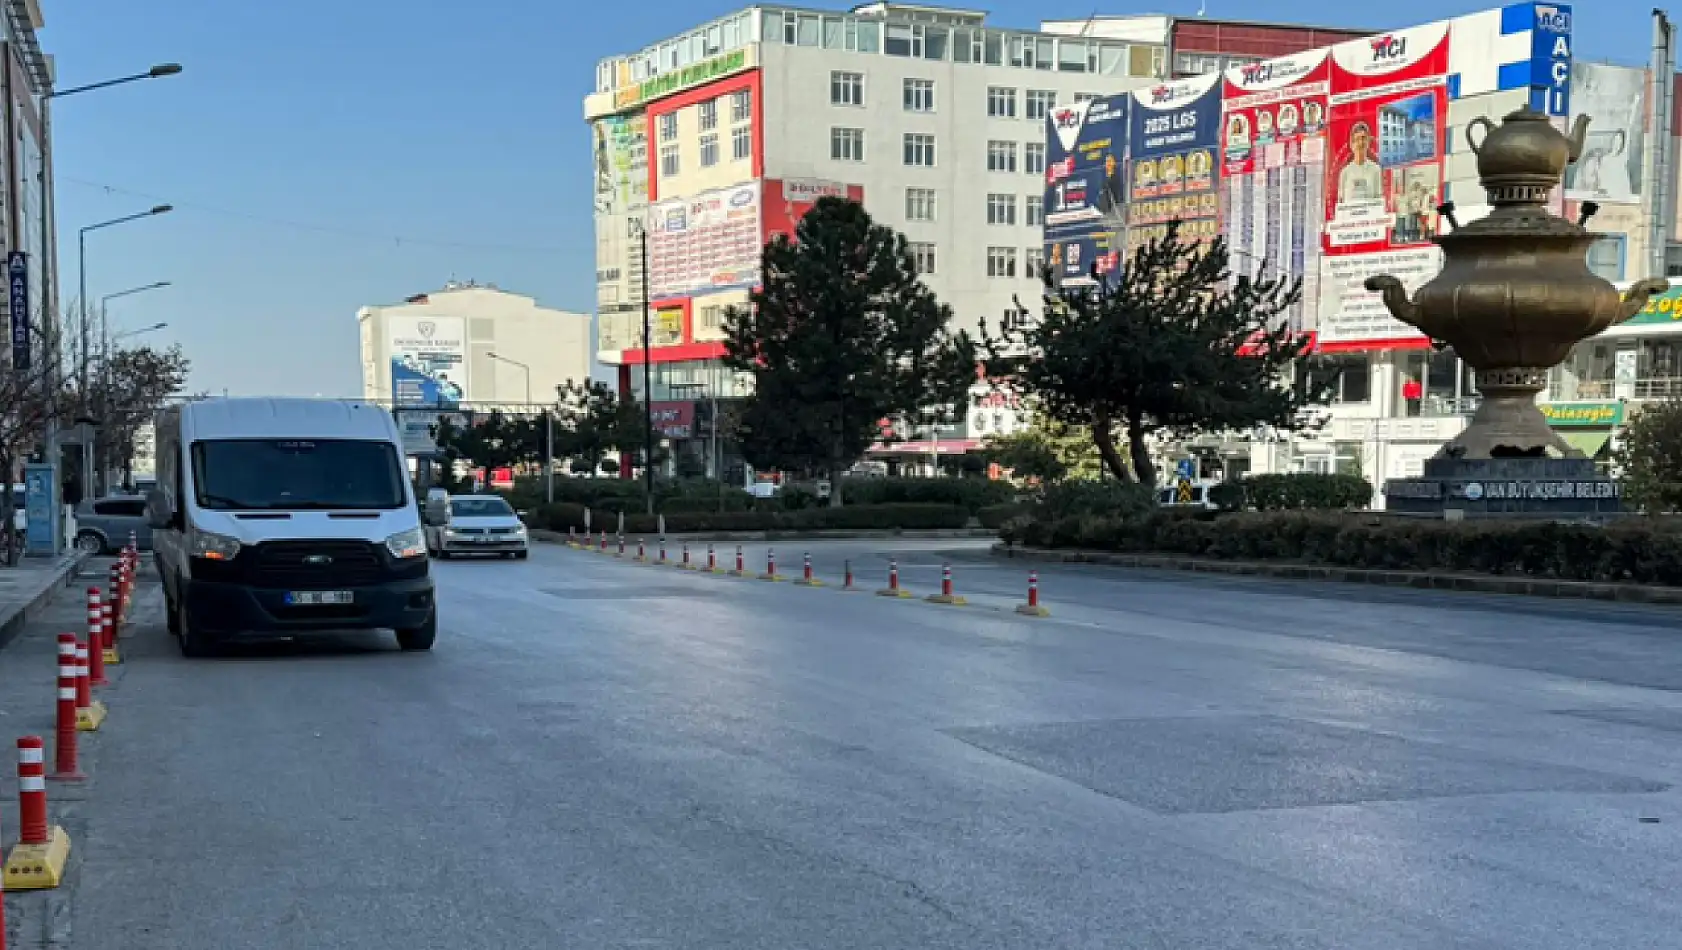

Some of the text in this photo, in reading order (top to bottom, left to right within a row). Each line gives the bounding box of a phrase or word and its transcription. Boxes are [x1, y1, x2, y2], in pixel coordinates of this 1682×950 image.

[1551, 36, 1571, 113] AÇI
[1172, 110, 1197, 129] LGS
[1486, 482, 1505, 499] VAN
